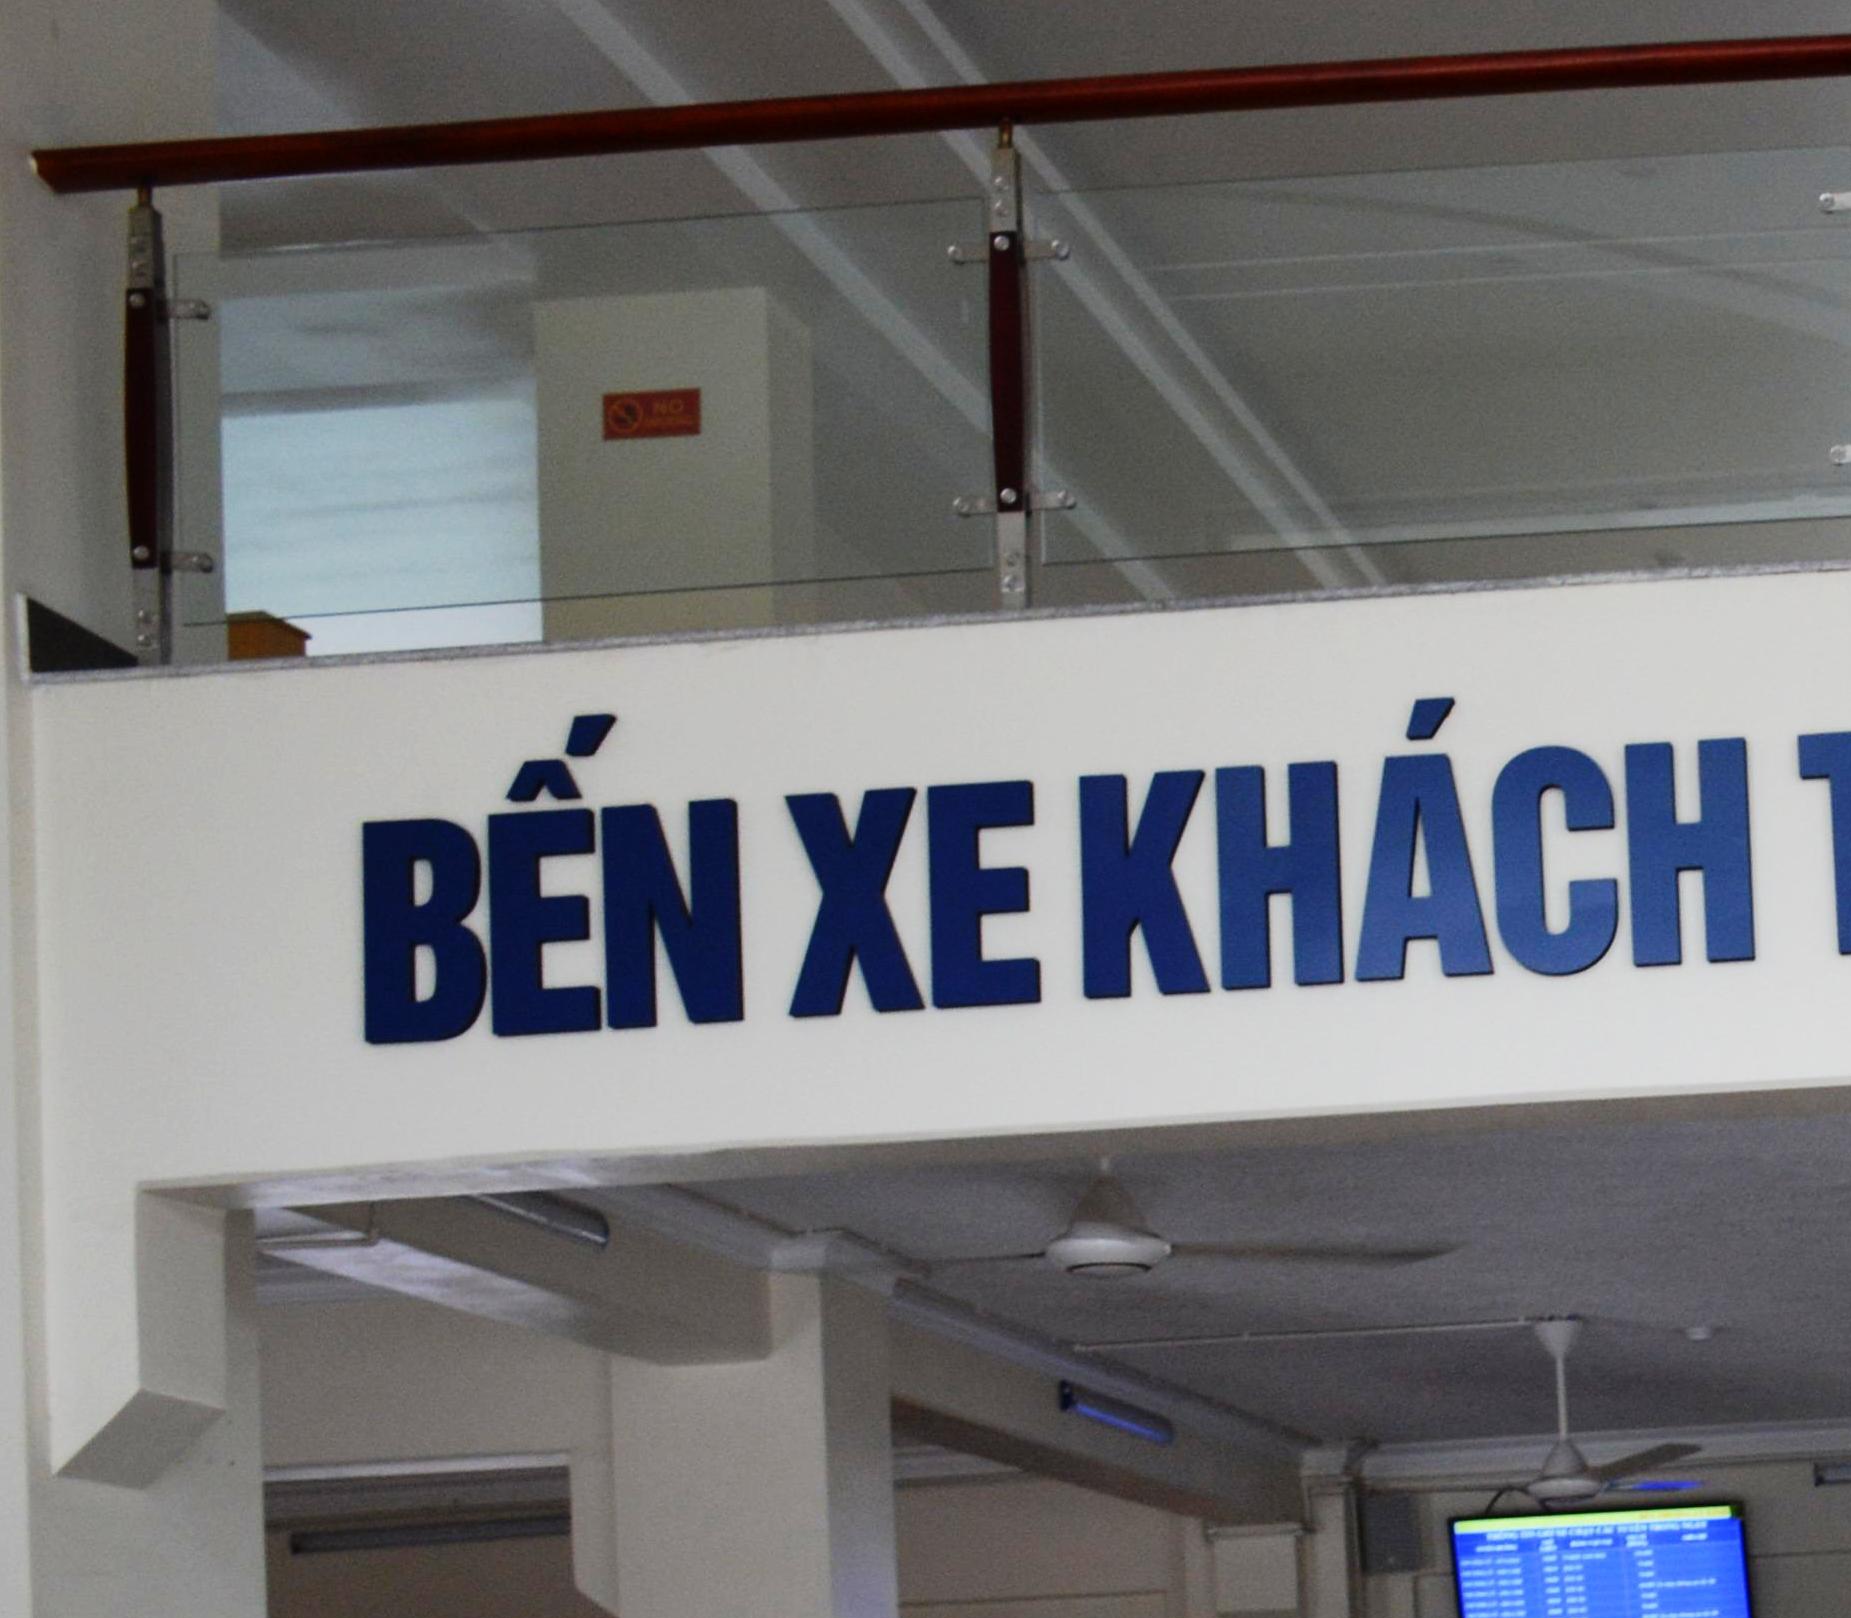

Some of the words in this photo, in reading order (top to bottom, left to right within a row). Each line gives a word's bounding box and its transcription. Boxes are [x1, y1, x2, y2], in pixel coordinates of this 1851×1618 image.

[362, 714, 744, 1045] BẾN
[785, 780, 1041, 1017] XE
[1079, 698, 1756, 999] KHÁCH
